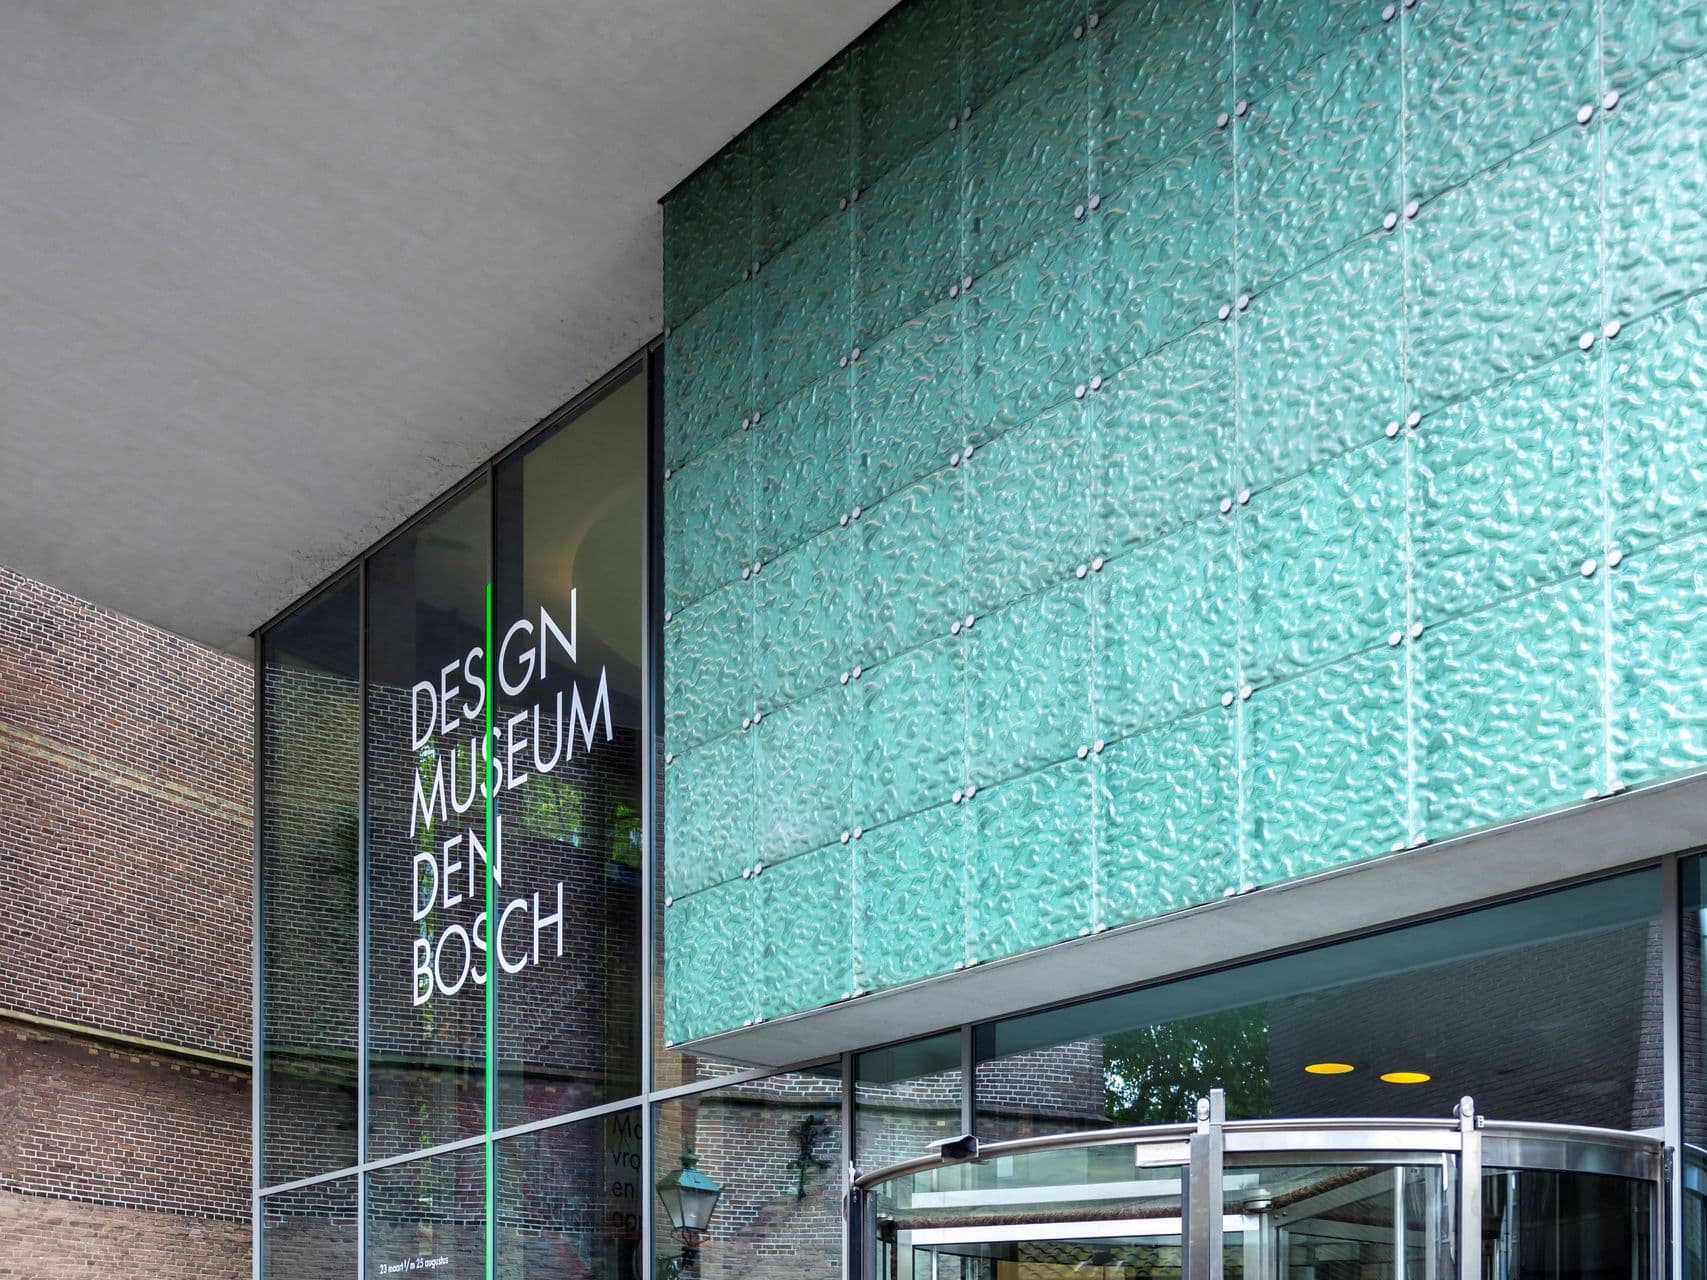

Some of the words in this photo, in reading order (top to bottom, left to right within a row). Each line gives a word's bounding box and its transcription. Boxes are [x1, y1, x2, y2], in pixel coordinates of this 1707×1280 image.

[412, 587, 577, 752] DESGN
[410, 664, 614, 838] MUSEUM
[413, 815, 502, 922] DEN
[413, 881, 563, 1007] BOSCH
[379, 1264, 387, 1274] 23
[388, 1262, 403, 1273] maart
[416, 1257, 424, 1269] 25
[424, 1256, 449, 1269] augustus
